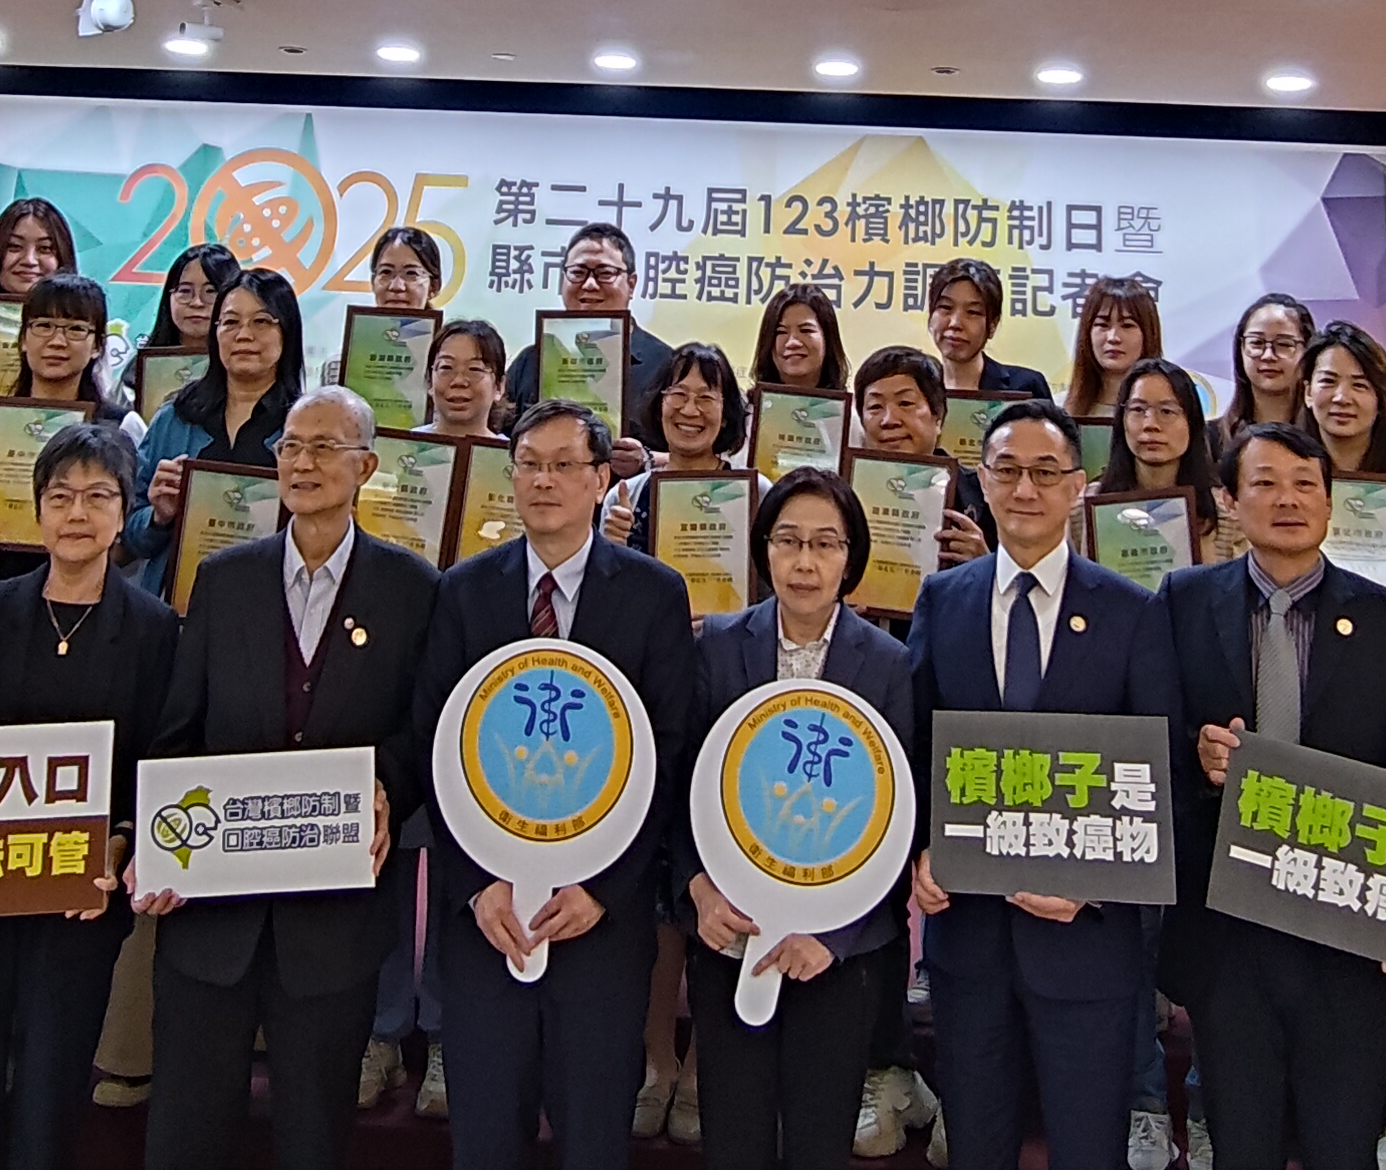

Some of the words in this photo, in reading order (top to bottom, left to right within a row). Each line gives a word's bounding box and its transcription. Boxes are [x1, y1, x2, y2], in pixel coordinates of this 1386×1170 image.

[480, 666, 514, 701] Ministry
[517, 657, 531, 671] of
[531, 655, 568, 670] Health
[571, 663, 593, 679] and
[594, 677, 621, 720] Welfare
[748, 701, 787, 730] Ministry
[789, 695, 802, 708] of
[804, 696, 841, 713] Health
[844, 710, 863, 729] and
[862, 727, 886, 775] Welfare
[946, 747, 1157, 812] 檳榔子是
[944, 811, 1158, 864] 一級致癌物
